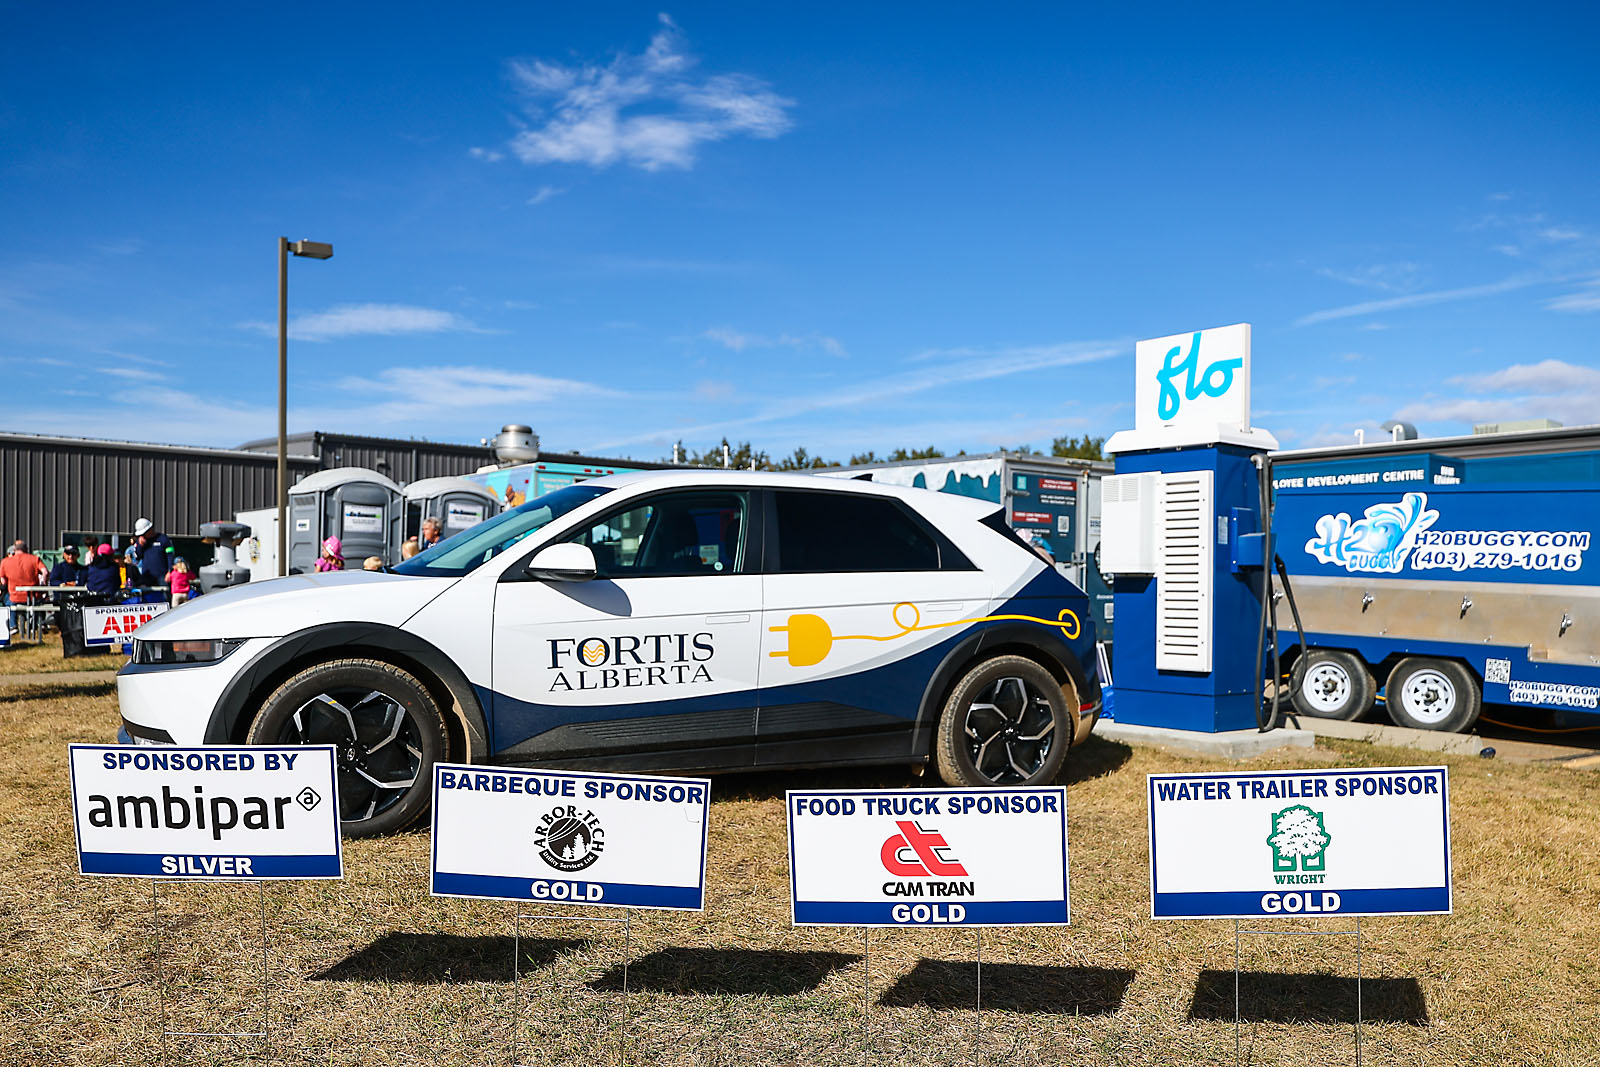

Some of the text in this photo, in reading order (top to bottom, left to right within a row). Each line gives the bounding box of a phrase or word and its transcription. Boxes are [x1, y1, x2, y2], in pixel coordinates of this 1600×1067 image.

[1156, 331, 1243, 421] flo
[1306, 472, 1380, 488] DEVELOPMENT
[1382, 469, 1425, 483] CENTRE
[1414, 550, 1578, 569] (403) 279-1016
[95, 605, 145, 615] SPONSORED
[114, 635, 134, 644] SILV
[546, 632, 714, 670] FORTIS
[548, 663, 714, 692] ALBERTA
[1510, 691, 1596, 707] (403) 279-1016
[103, 752, 299, 771] SPONSORED BY
[440, 771, 704, 805] BARBEQUE SPONSOR
[1157, 775, 1439, 802] WATER TRAILER SPONSOR
[88, 785, 292, 841] ambipar
[796, 795, 1059, 816] FOOD TRUCK SPONSOR
[533, 804, 605, 853] ARBOR-TECH
[161, 855, 254, 876] SILVER
[542, 850, 595, 869] Utility Services Ltd.
[882, 881, 975, 897] CAM TRAN
[1273, 873, 1326, 885] WRIGHT
[530, 880, 604, 902] GOLD
[1260, 892, 1342, 913] GOLD
[891, 904, 967, 923] GOLD
